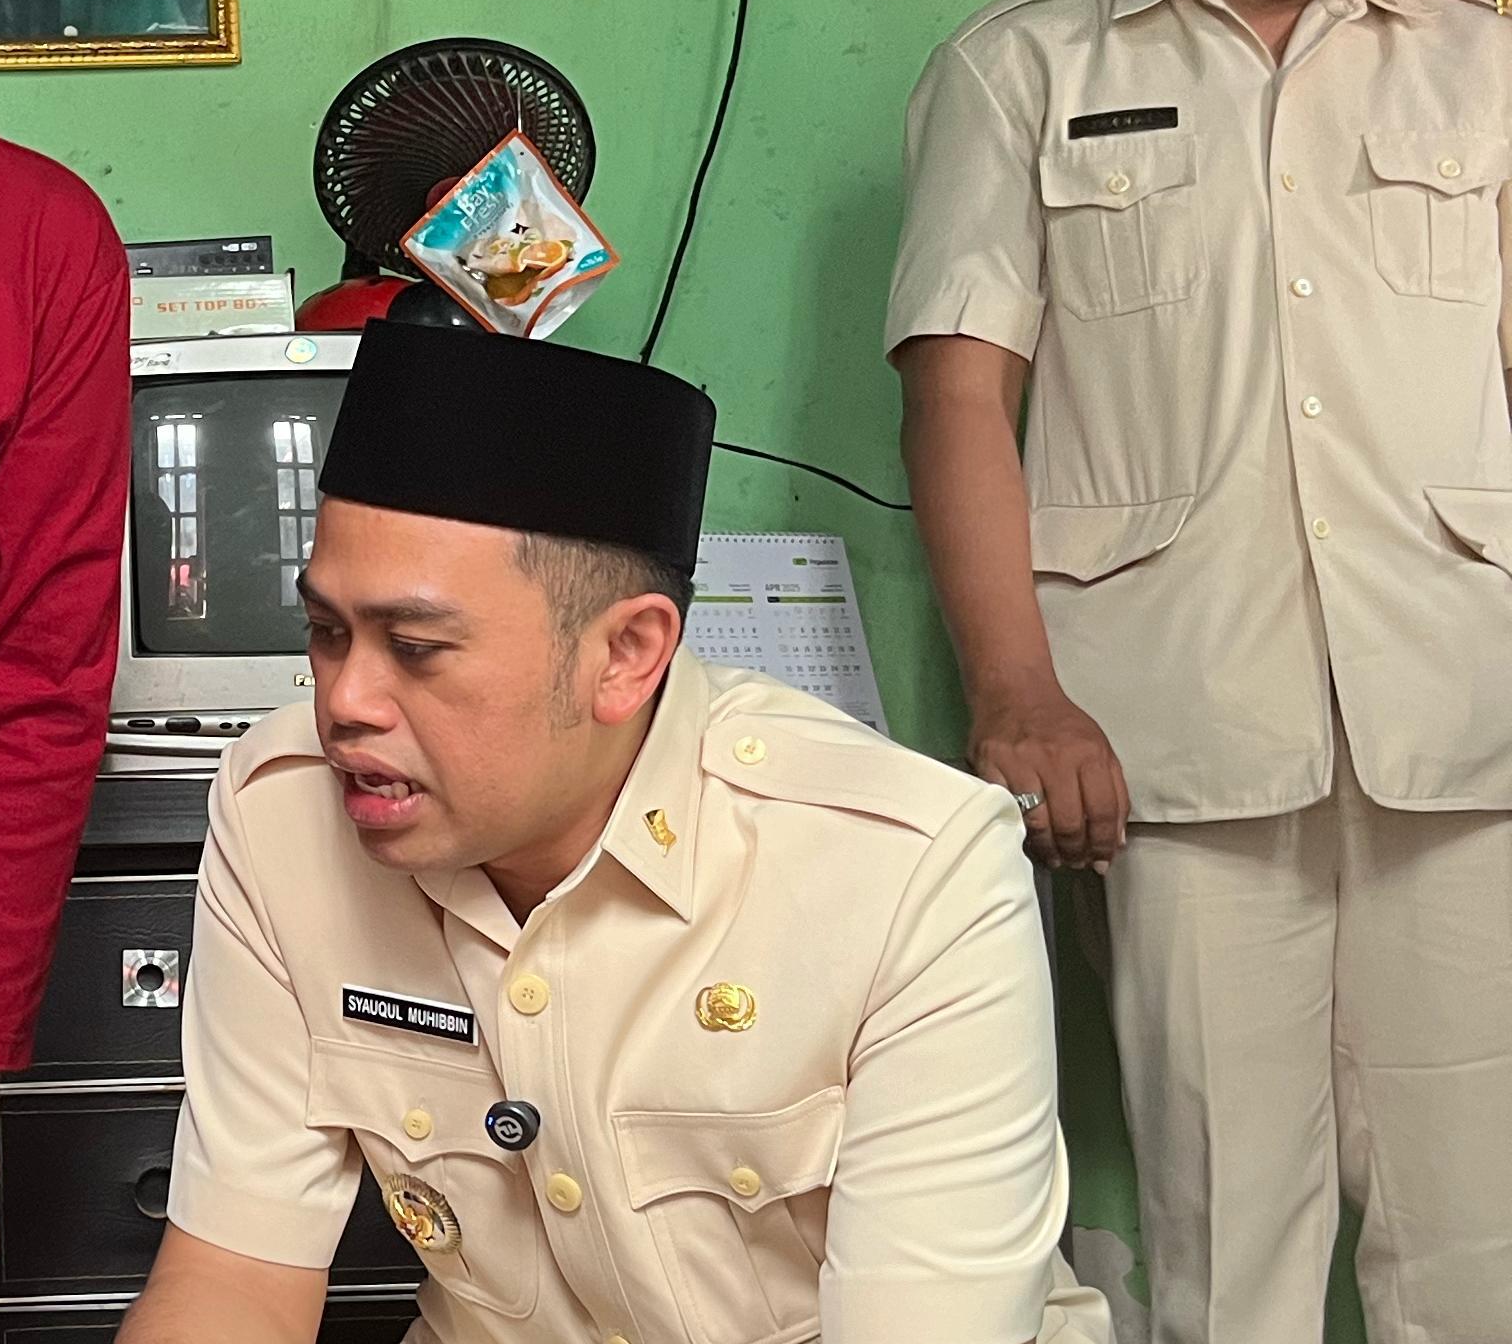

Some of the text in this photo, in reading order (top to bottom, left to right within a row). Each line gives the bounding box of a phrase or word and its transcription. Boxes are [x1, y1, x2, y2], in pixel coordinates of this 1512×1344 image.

[157, 297, 269, 313] SET TOP BOX
[348, 994, 468, 1035] SYAUQUL MUHIBBIN
